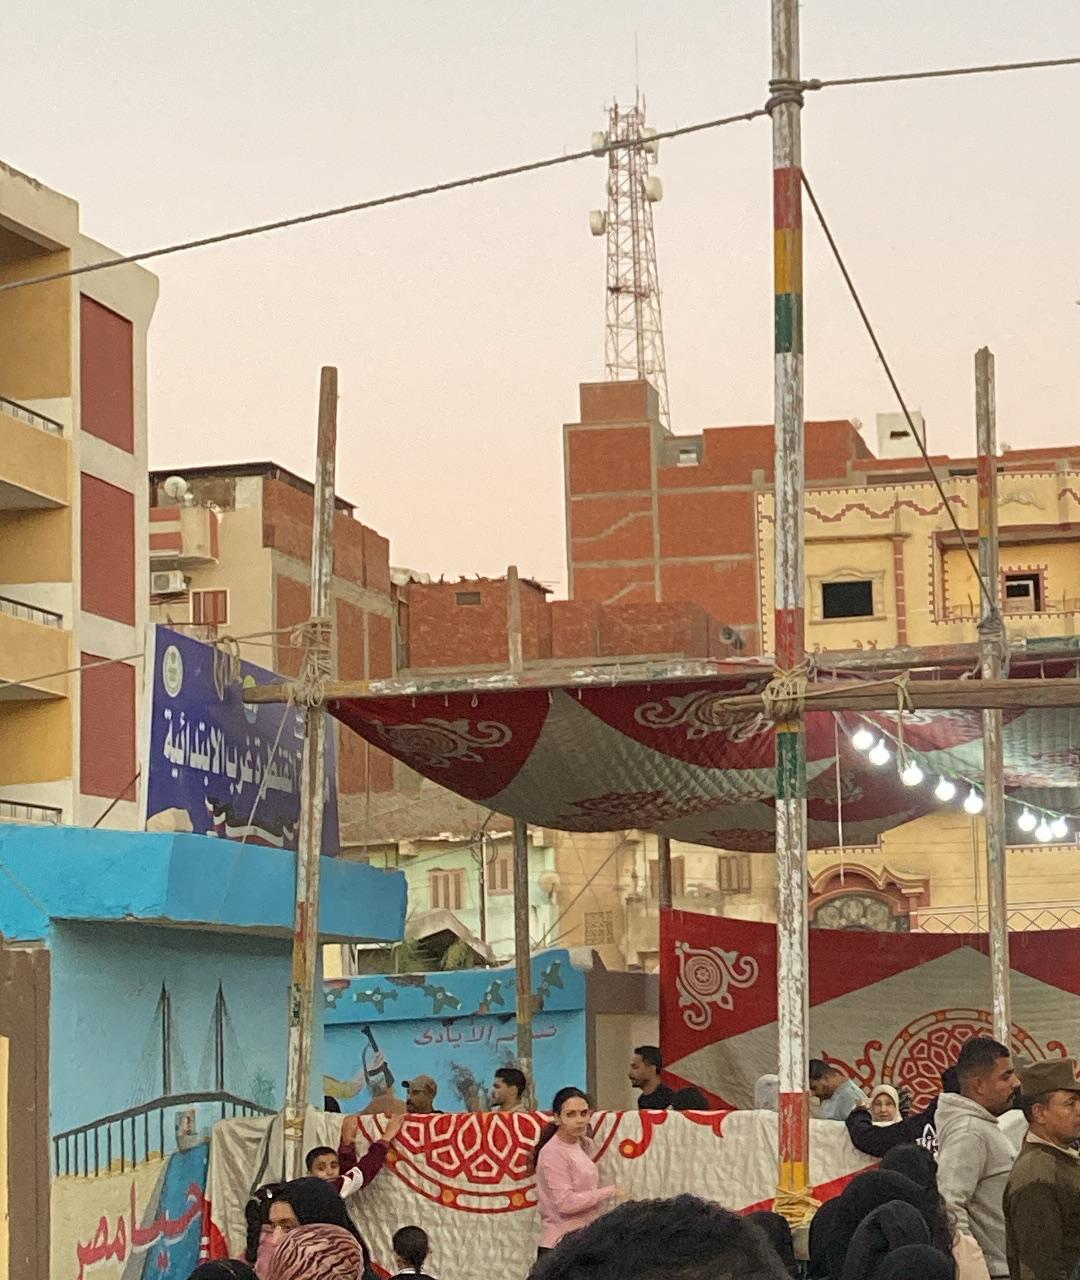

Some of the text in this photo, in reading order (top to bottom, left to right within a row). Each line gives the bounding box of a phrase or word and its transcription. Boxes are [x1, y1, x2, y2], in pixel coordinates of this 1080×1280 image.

[163, 708, 225, 787] الابتدائية
[226, 735, 254, 795] غرب
[130, 1180, 204, 1274] حيا
